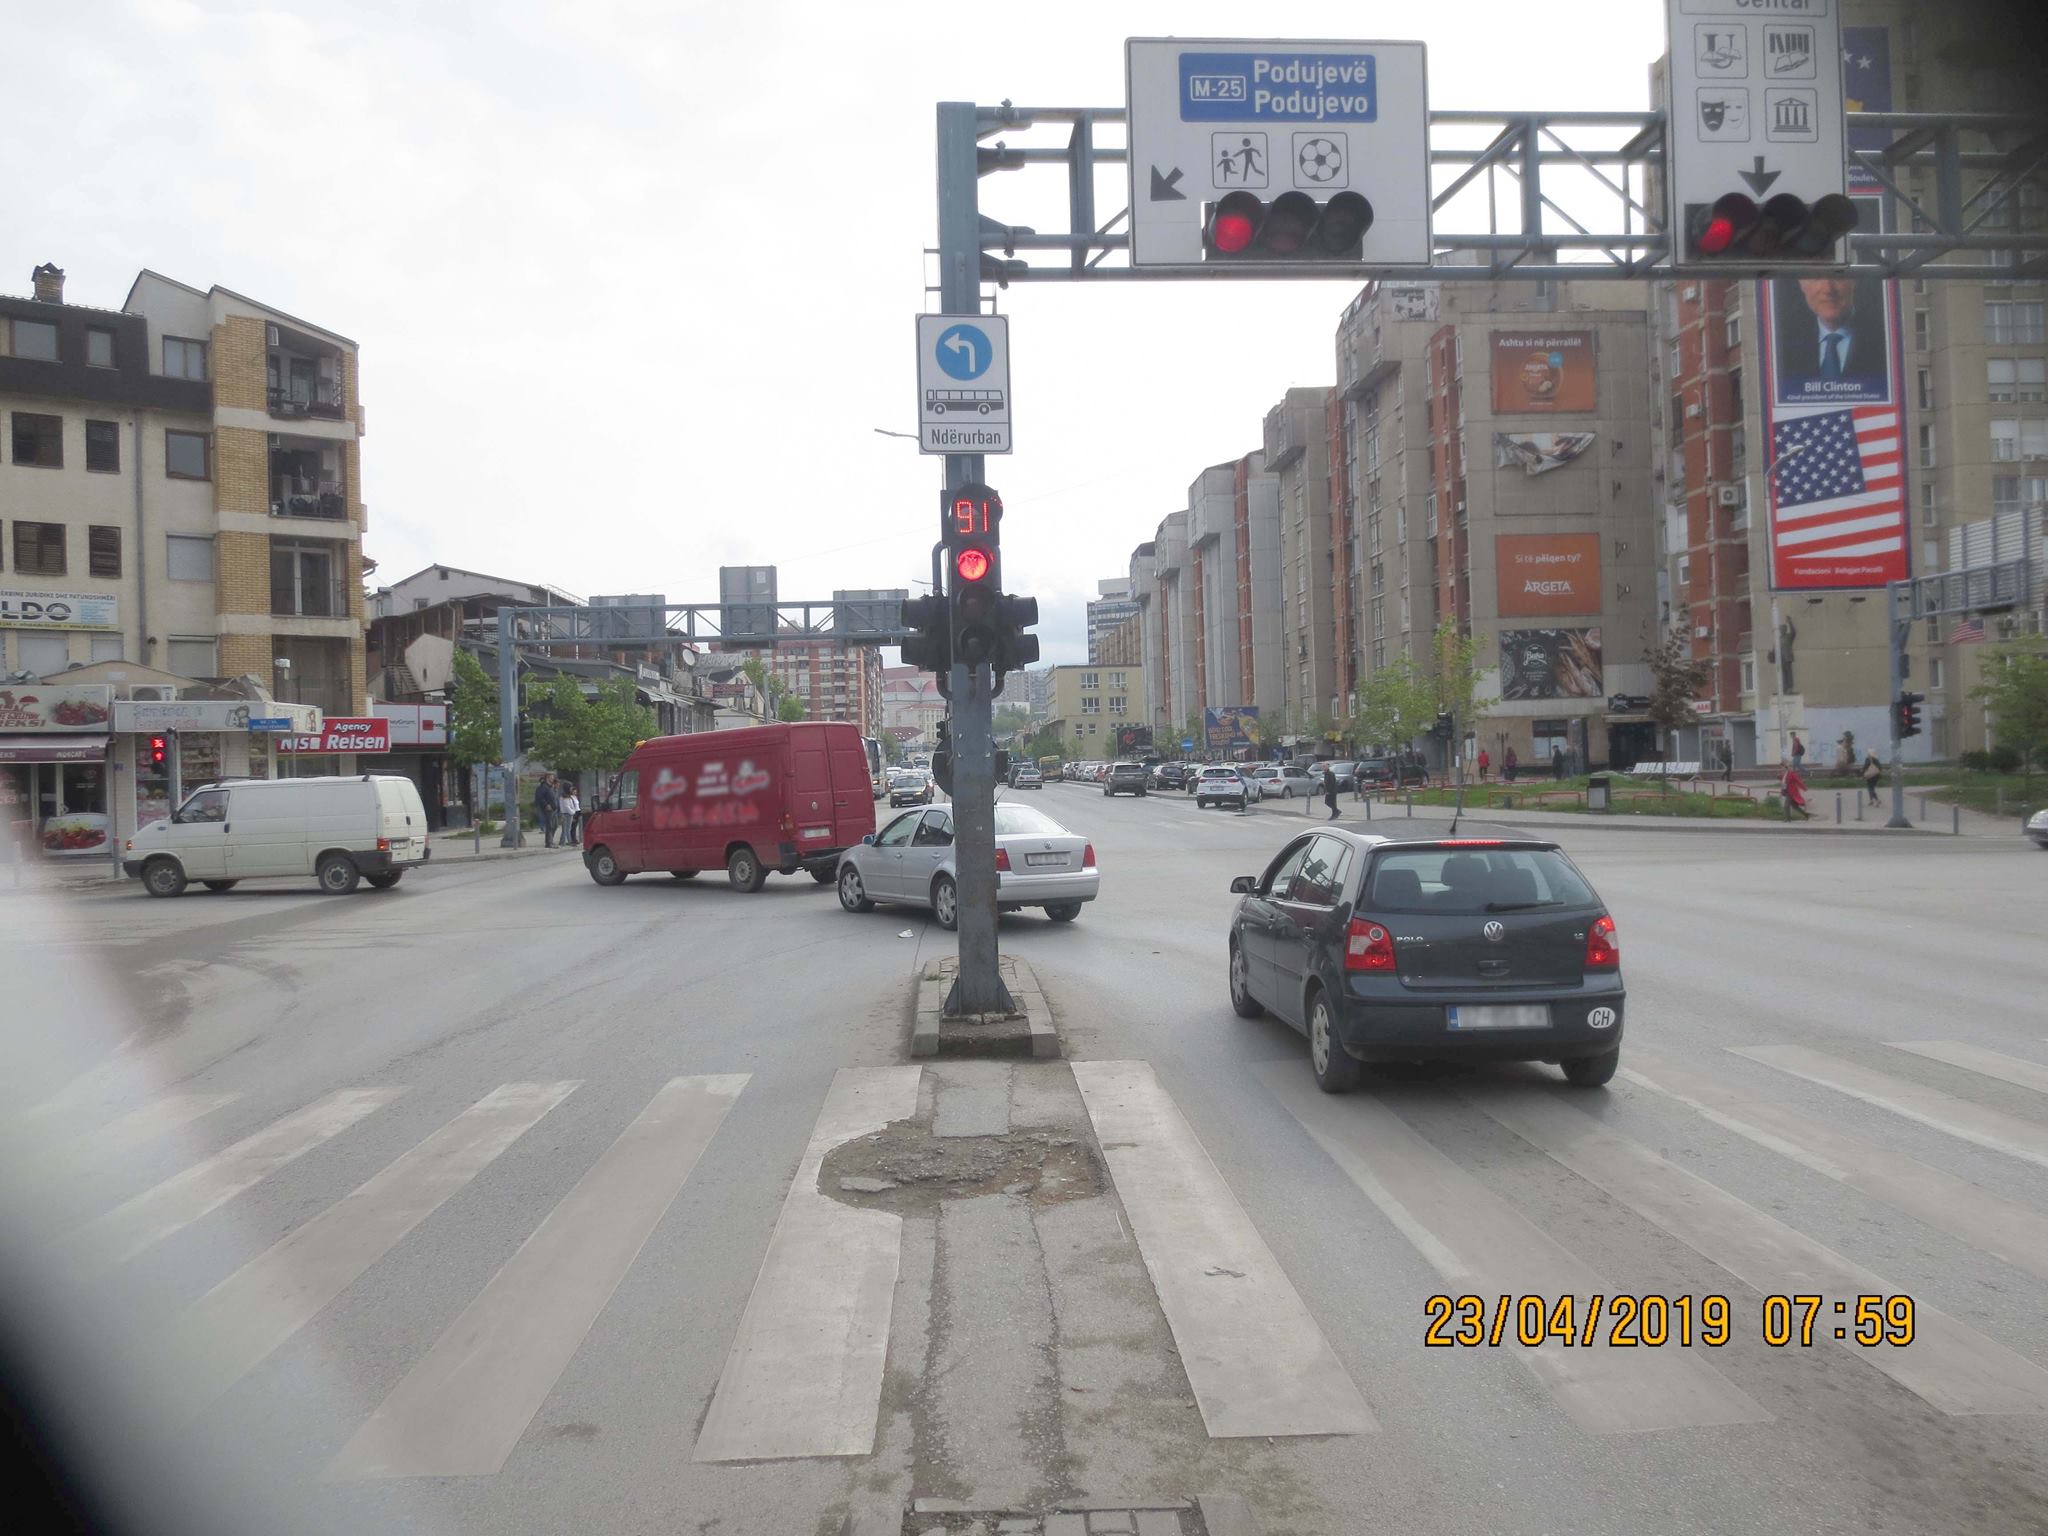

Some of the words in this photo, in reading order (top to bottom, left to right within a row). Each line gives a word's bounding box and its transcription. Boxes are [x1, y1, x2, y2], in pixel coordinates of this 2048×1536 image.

[1254, 60, 1367, 88] Podujevë
[1194, 80, 1242, 97] M-25
[1254, 91, 1368, 119] Podujevo
[1499, 338, 1524, 347] Ashtu
[1804, 382, 1821, 392] Bill
[1823, 381, 1861, 392] Clinton
[932, 429, 1001, 445] Ndërurban
[956, 501, 989, 533] 91
[1524, 579, 1572, 595] ARGETA
[334, 722, 372, 732] Agency
[326, 734, 385, 750] Reisen
[1592, 1011, 1610, 1026] CH
